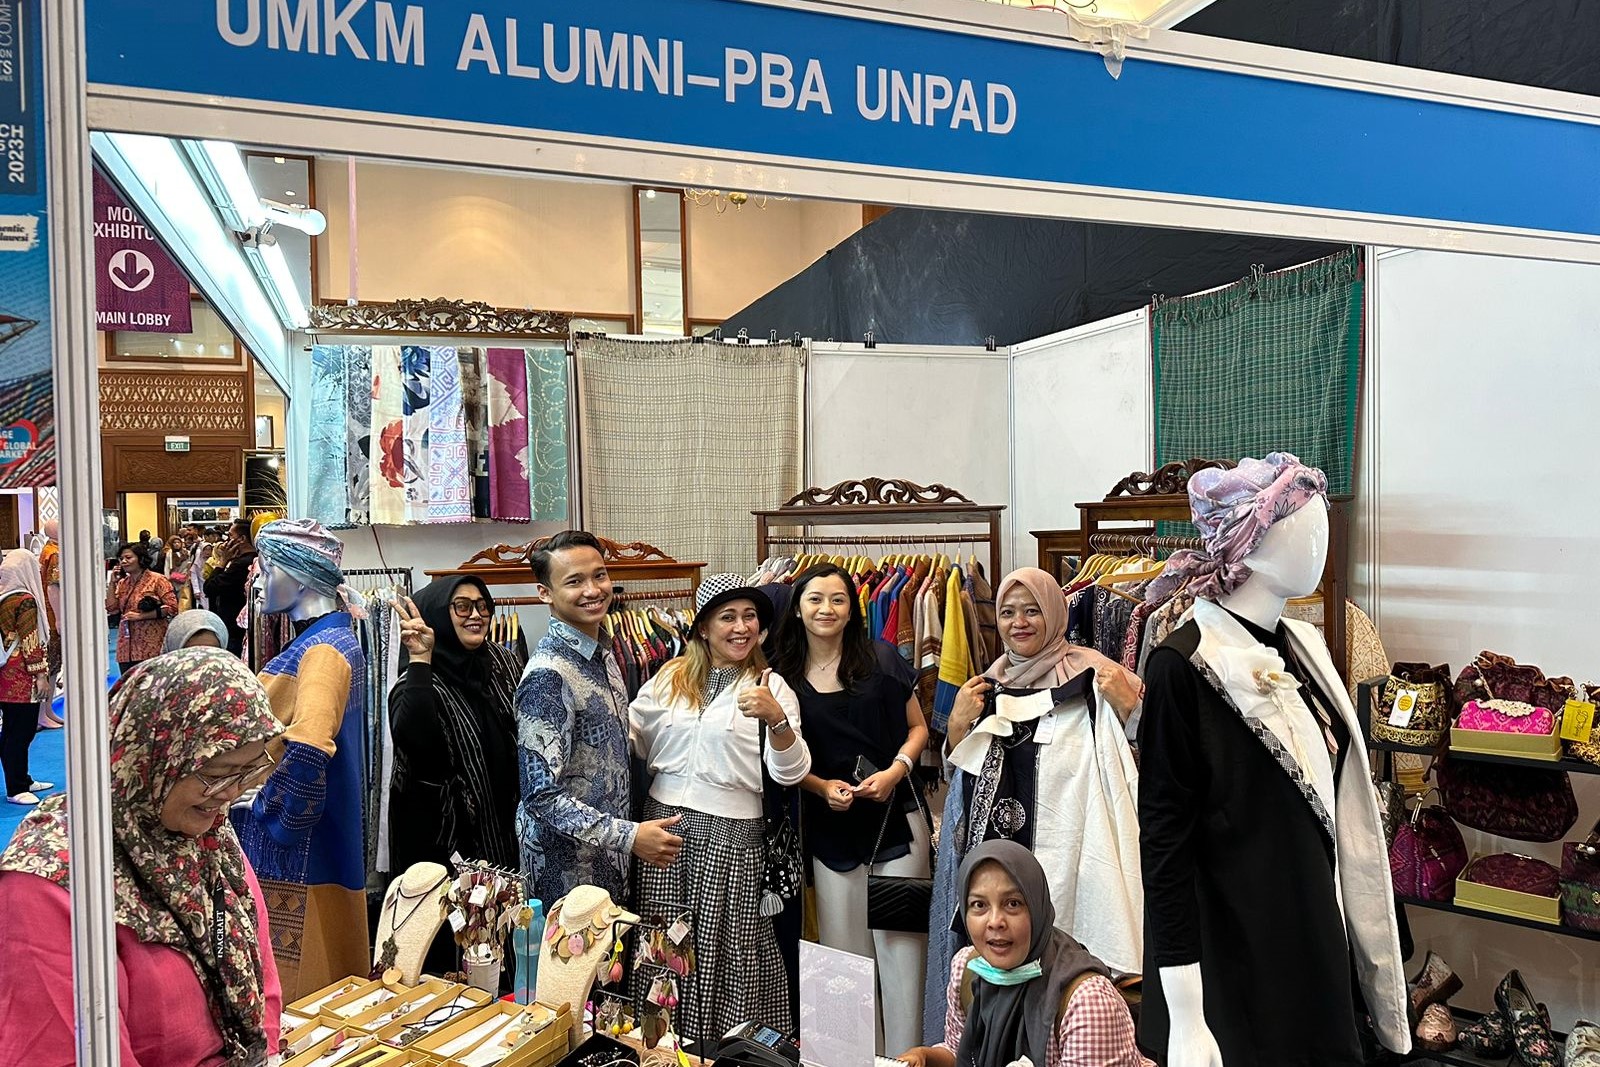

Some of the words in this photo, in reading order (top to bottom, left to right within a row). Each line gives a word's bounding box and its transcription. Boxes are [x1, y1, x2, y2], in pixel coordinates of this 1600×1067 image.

[215, 0, 425, 66] UMKM
[855, 65, 1018, 135] UNPAD
[8, 139, 25, 183] 2023
[95, 311, 126, 324] MAIN
[130, 312, 172, 327] LOBBY
[3, 441, 37, 450] GLOBAL
[216, 910, 224, 958] INACRAFT
